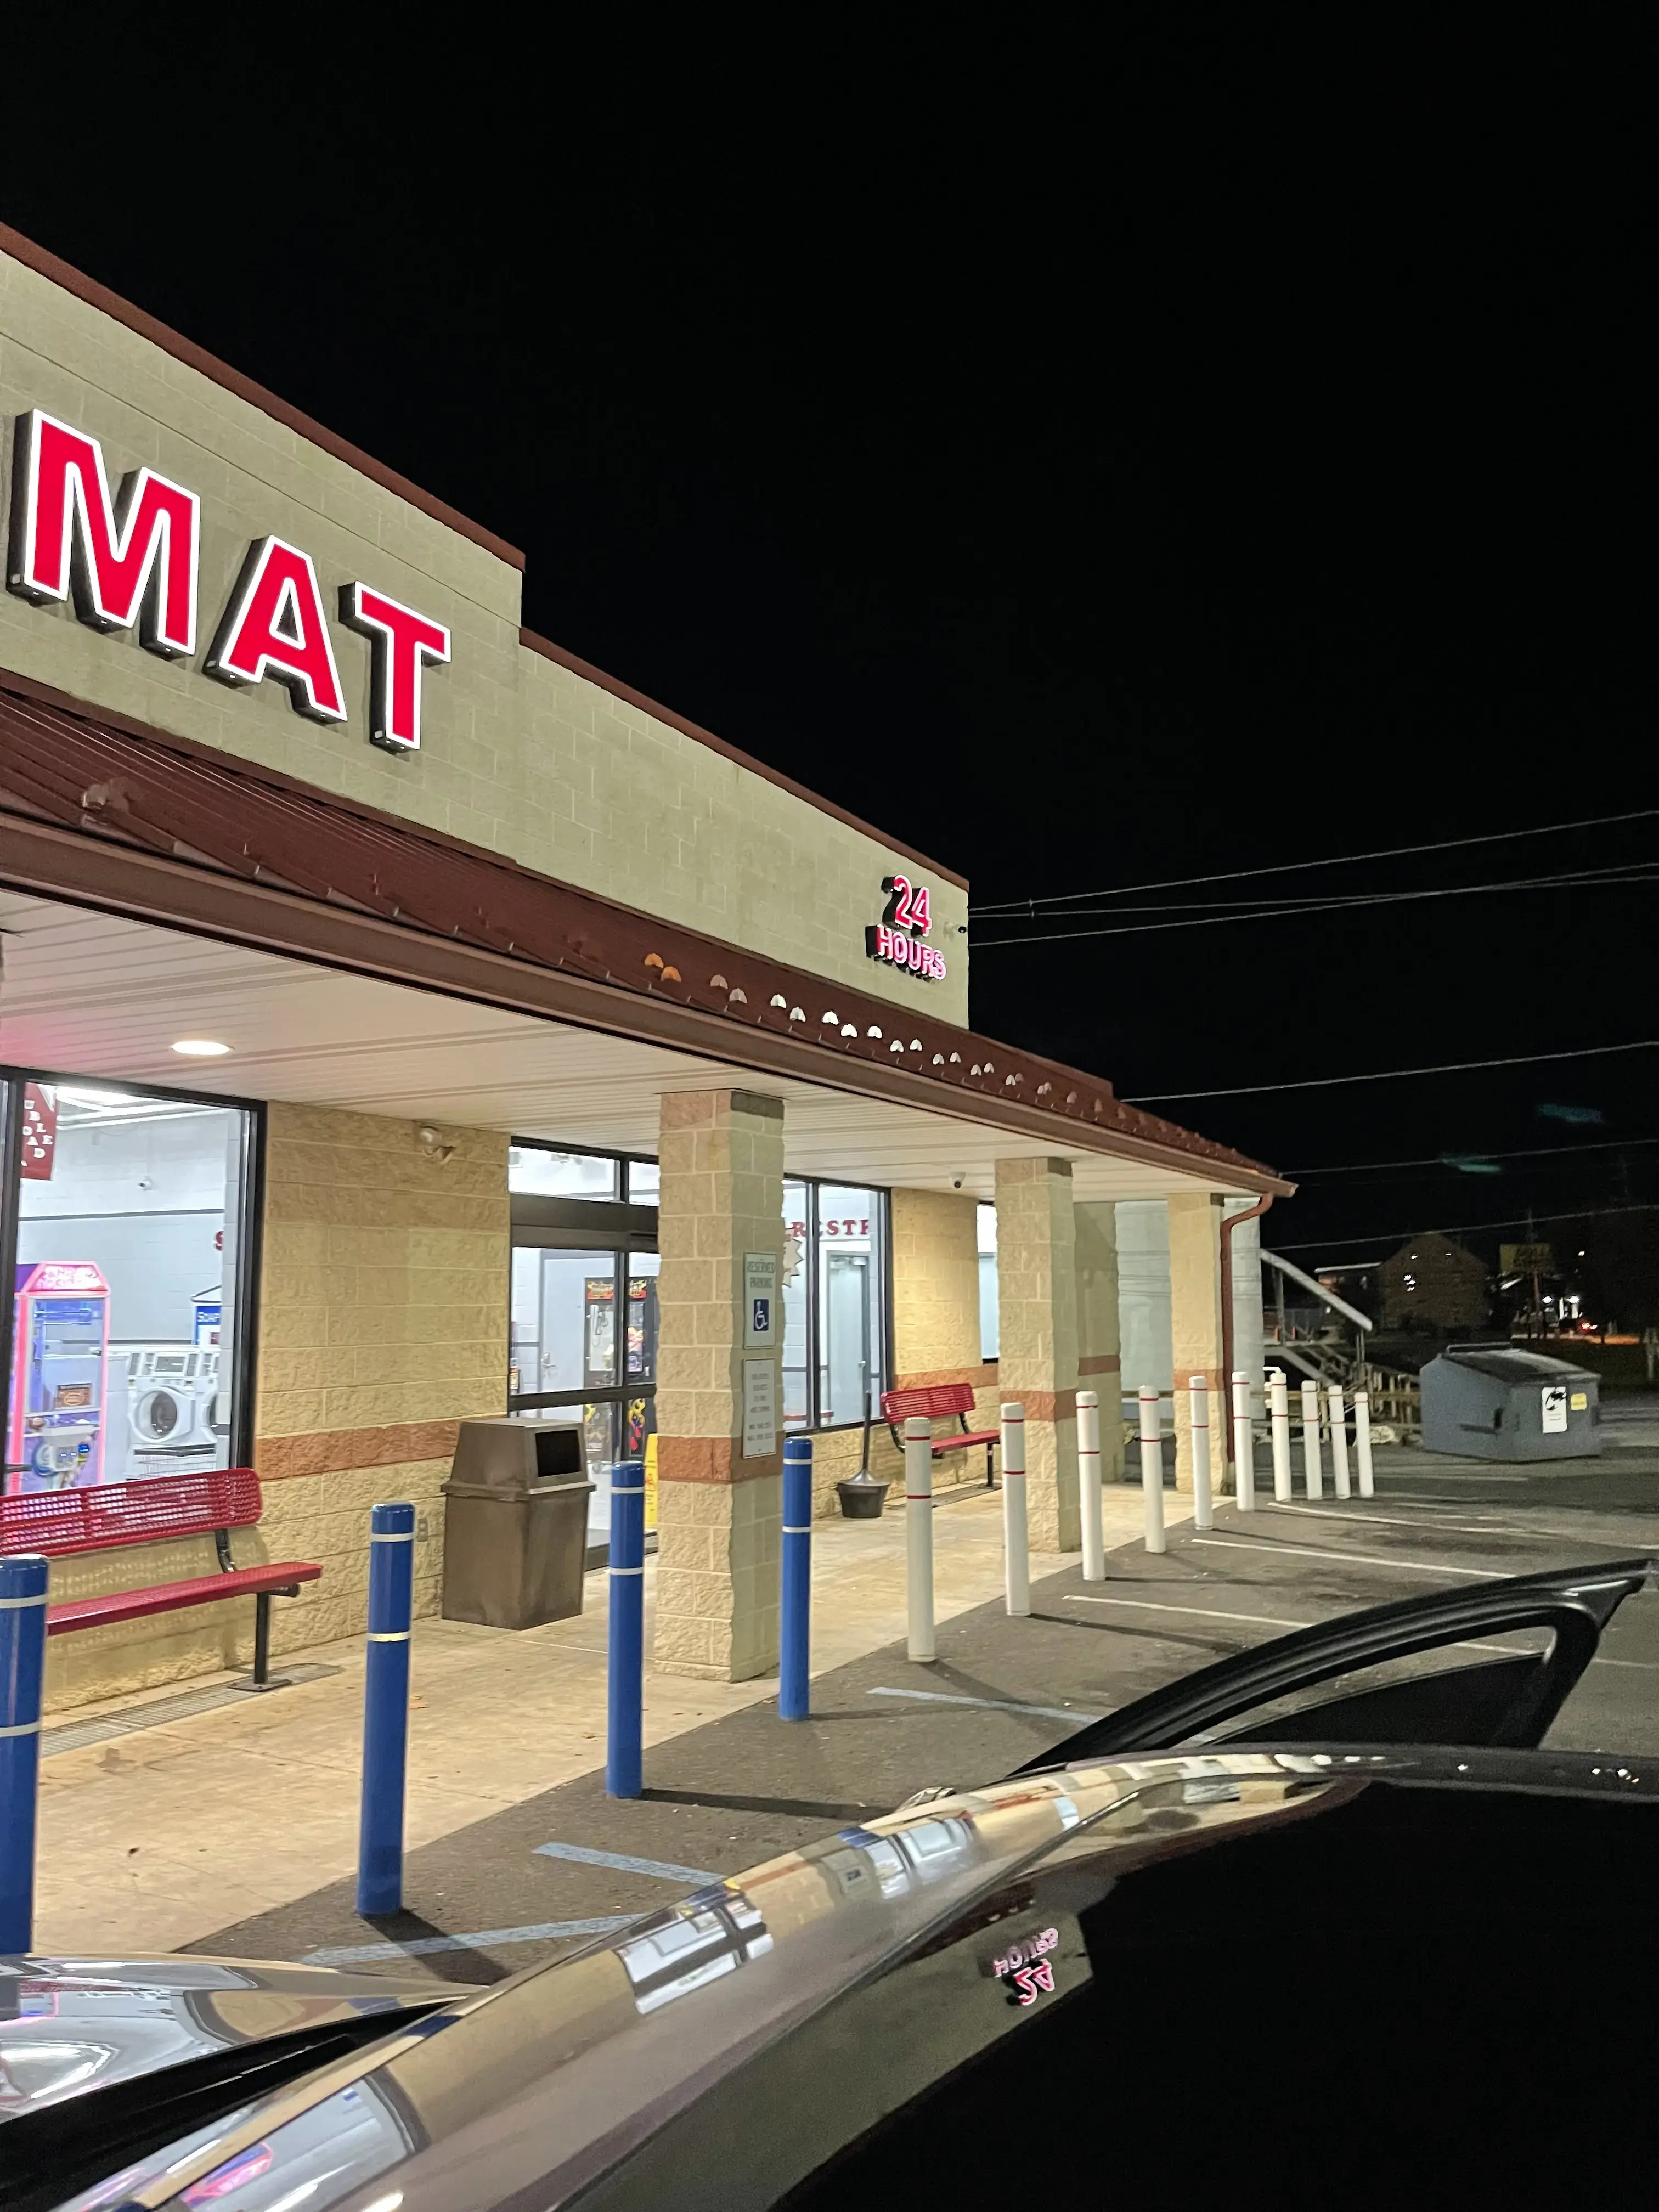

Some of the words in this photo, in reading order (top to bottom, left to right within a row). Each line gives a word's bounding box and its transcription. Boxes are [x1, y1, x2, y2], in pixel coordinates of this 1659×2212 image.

[14, 408, 451, 752] MAT
[888, 874, 932, 938] 24
[873, 924, 947, 980] HOURS
